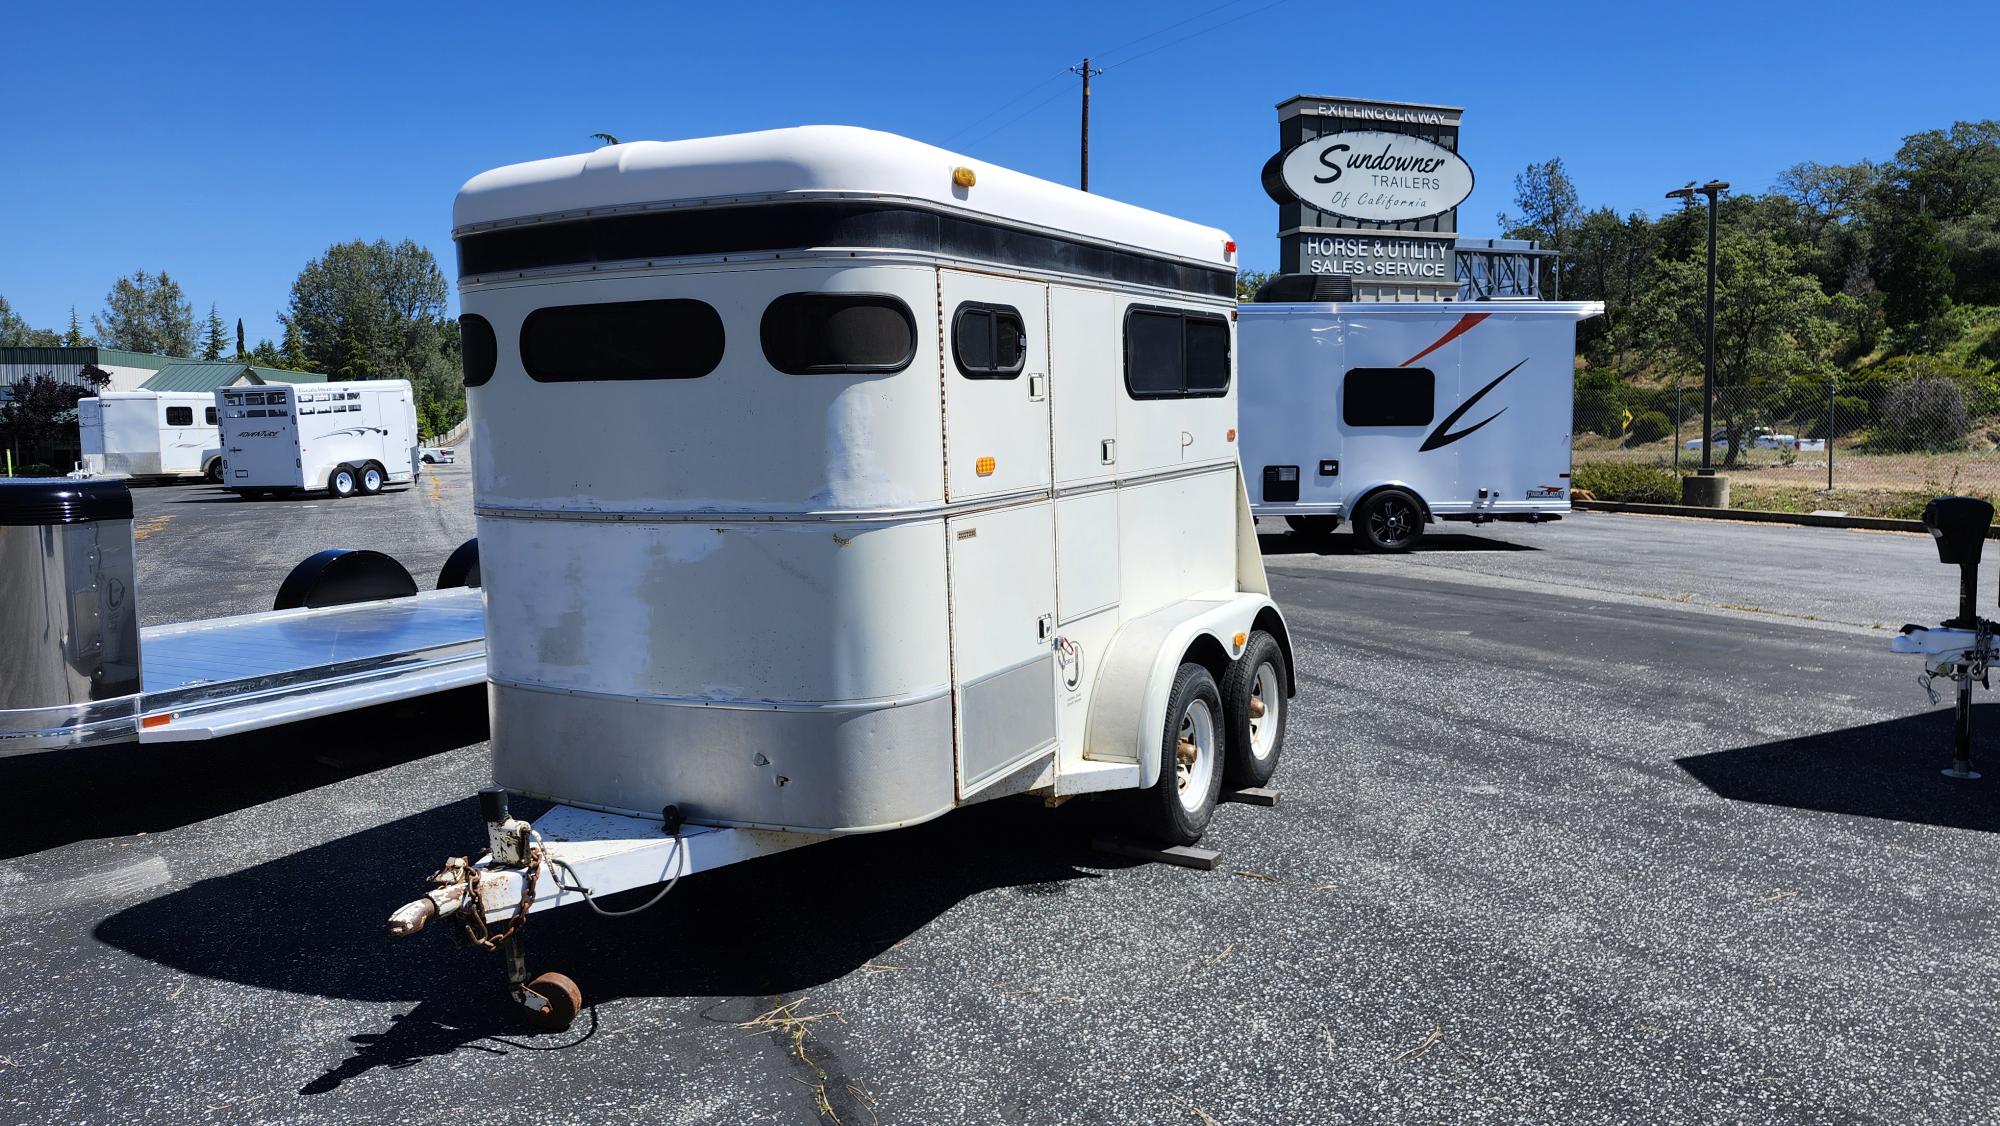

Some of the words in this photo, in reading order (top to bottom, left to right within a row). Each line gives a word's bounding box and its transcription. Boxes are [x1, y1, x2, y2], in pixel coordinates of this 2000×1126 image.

[1318, 103, 1353, 115] EXIT
[1353, 106, 1414, 121] LINCOLN
[1418, 113, 1445, 124] WAY
[1314, 143, 1445, 184] Sundowner
[1372, 175, 1440, 190] TRAILERS
[1331, 191, 1350, 206] Of
[1357, 192, 1427, 210] California
[1307, 238, 1368, 257] HORSE
[1373, 241, 1383, 255] &
[1388, 241, 1448, 260] UTILITY
